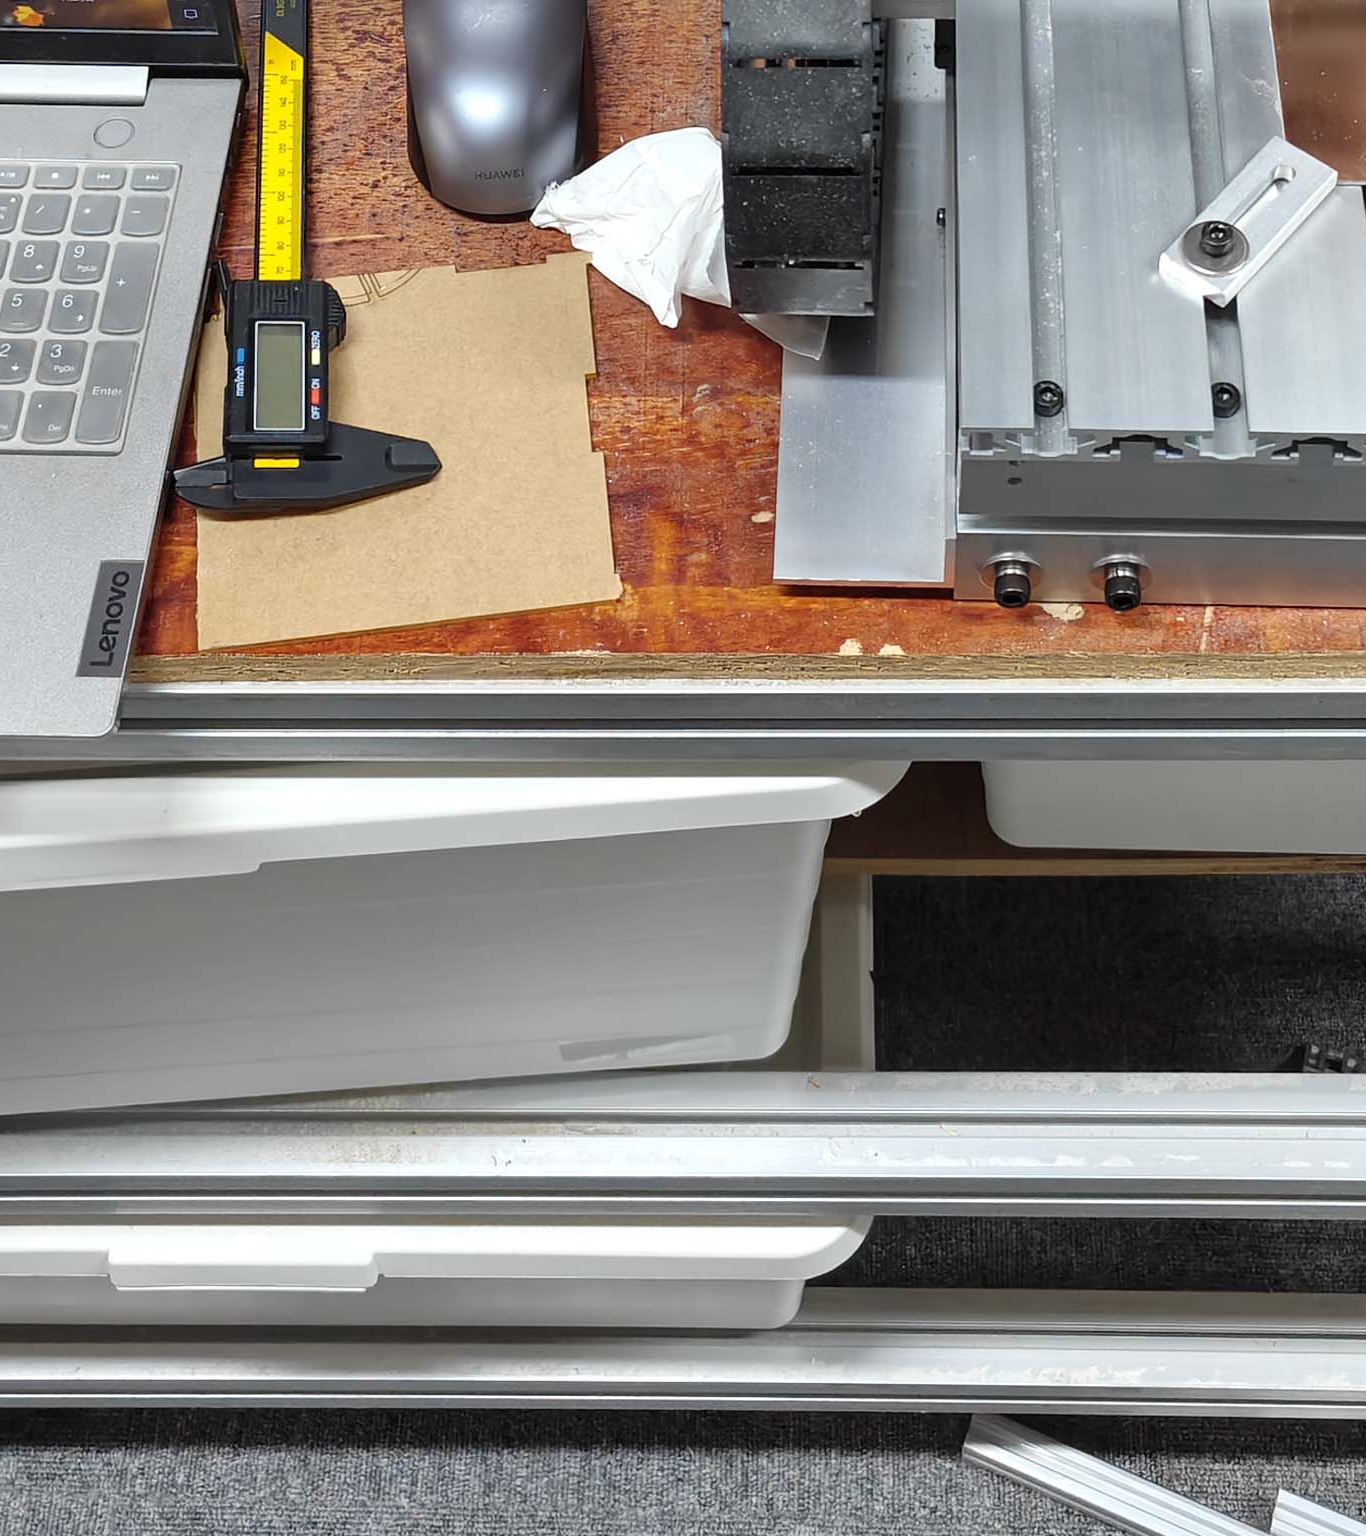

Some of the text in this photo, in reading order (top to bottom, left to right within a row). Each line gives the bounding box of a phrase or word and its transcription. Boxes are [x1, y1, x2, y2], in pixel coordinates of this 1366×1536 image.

[475, 167, 525, 180] HUAWEI
[23, 244, 35, 257] 8
[73, 244, 85, 258] 9
[11, 293, 23, 307] 5
[62, 294, 73, 307] 6
[50, 344, 63, 358] 3
[92, 385, 123, 396] Enter
[311, 405, 320, 420] OFF
[90, 571, 130, 667] Lenovo
